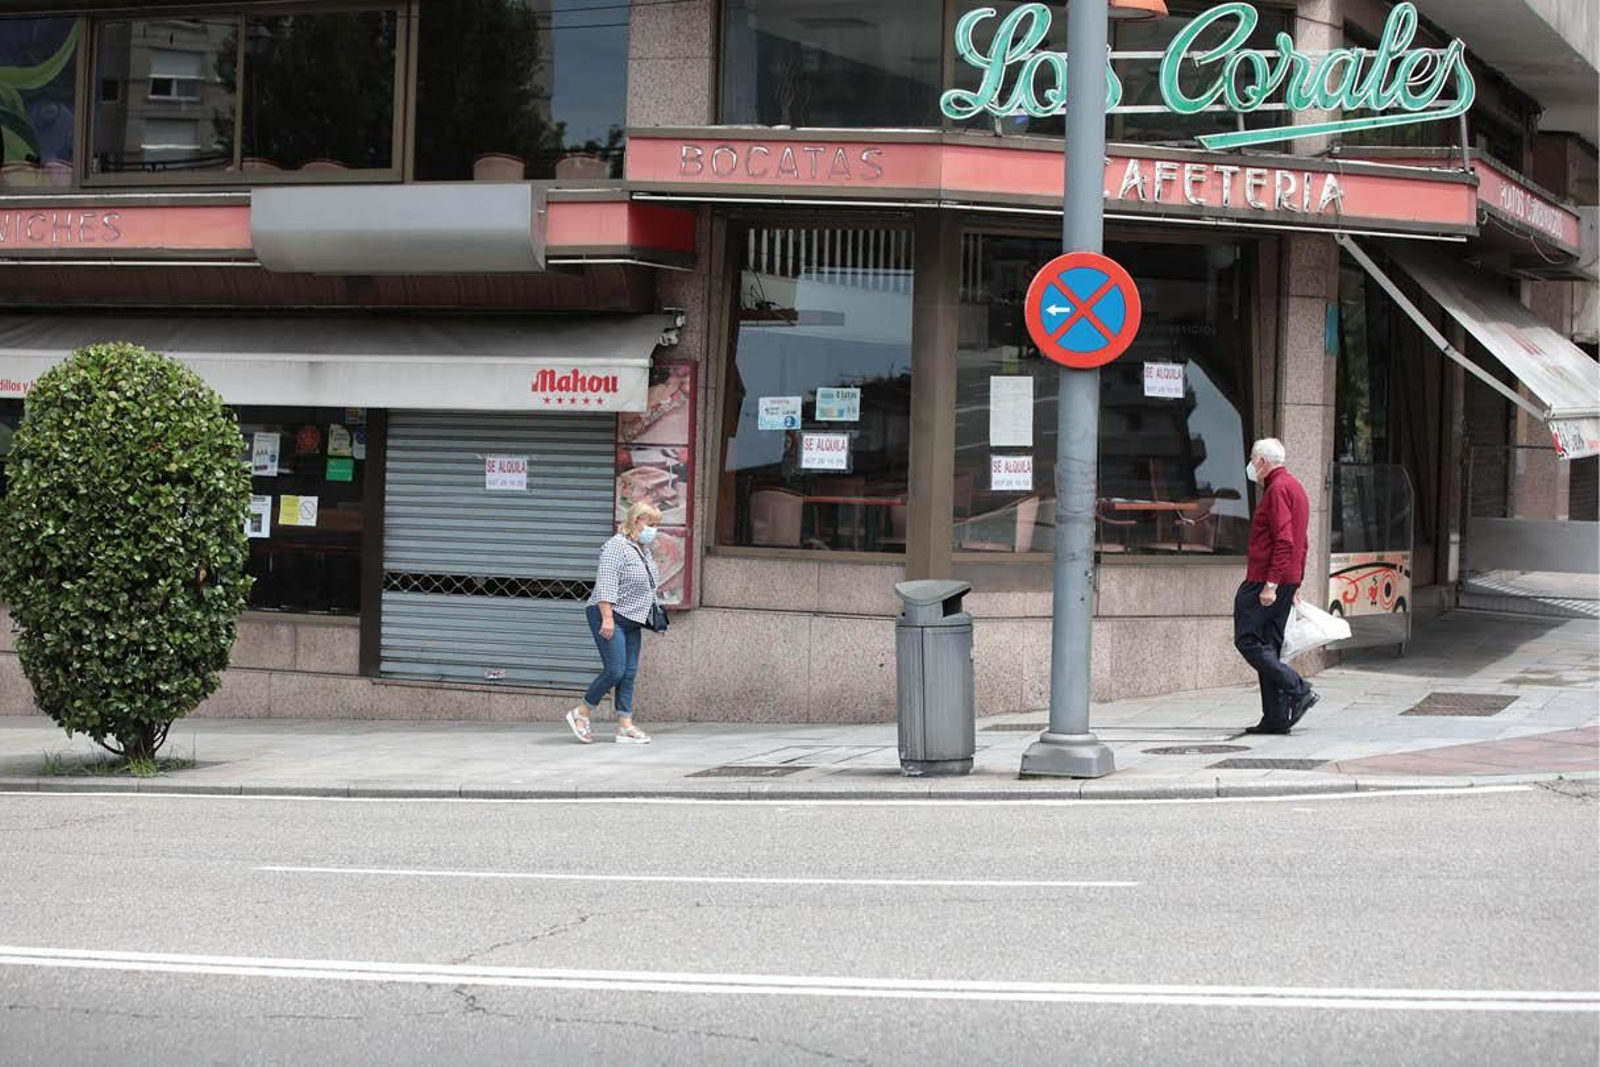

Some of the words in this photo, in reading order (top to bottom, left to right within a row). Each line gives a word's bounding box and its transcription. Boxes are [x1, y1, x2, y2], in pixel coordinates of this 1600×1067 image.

[1159, 2, 1475, 149] Corales
[679, 144, 885, 181] BOCATAS
[1104, 157, 1344, 214] AFETERIA
[531, 368, 618, 393] Mahou
[1145, 366, 1154, 379] SE
[1156, 366, 1182, 380] ALQUILA
[804, 438, 813, 451] SE
[816, 438, 846, 452] ALQUILA
[487, 460, 496, 473] SE
[498, 460, 527, 474] ALQUILA
[993, 460, 1002, 473] SE
[1004, 460, 1032, 474] ALQUILA
